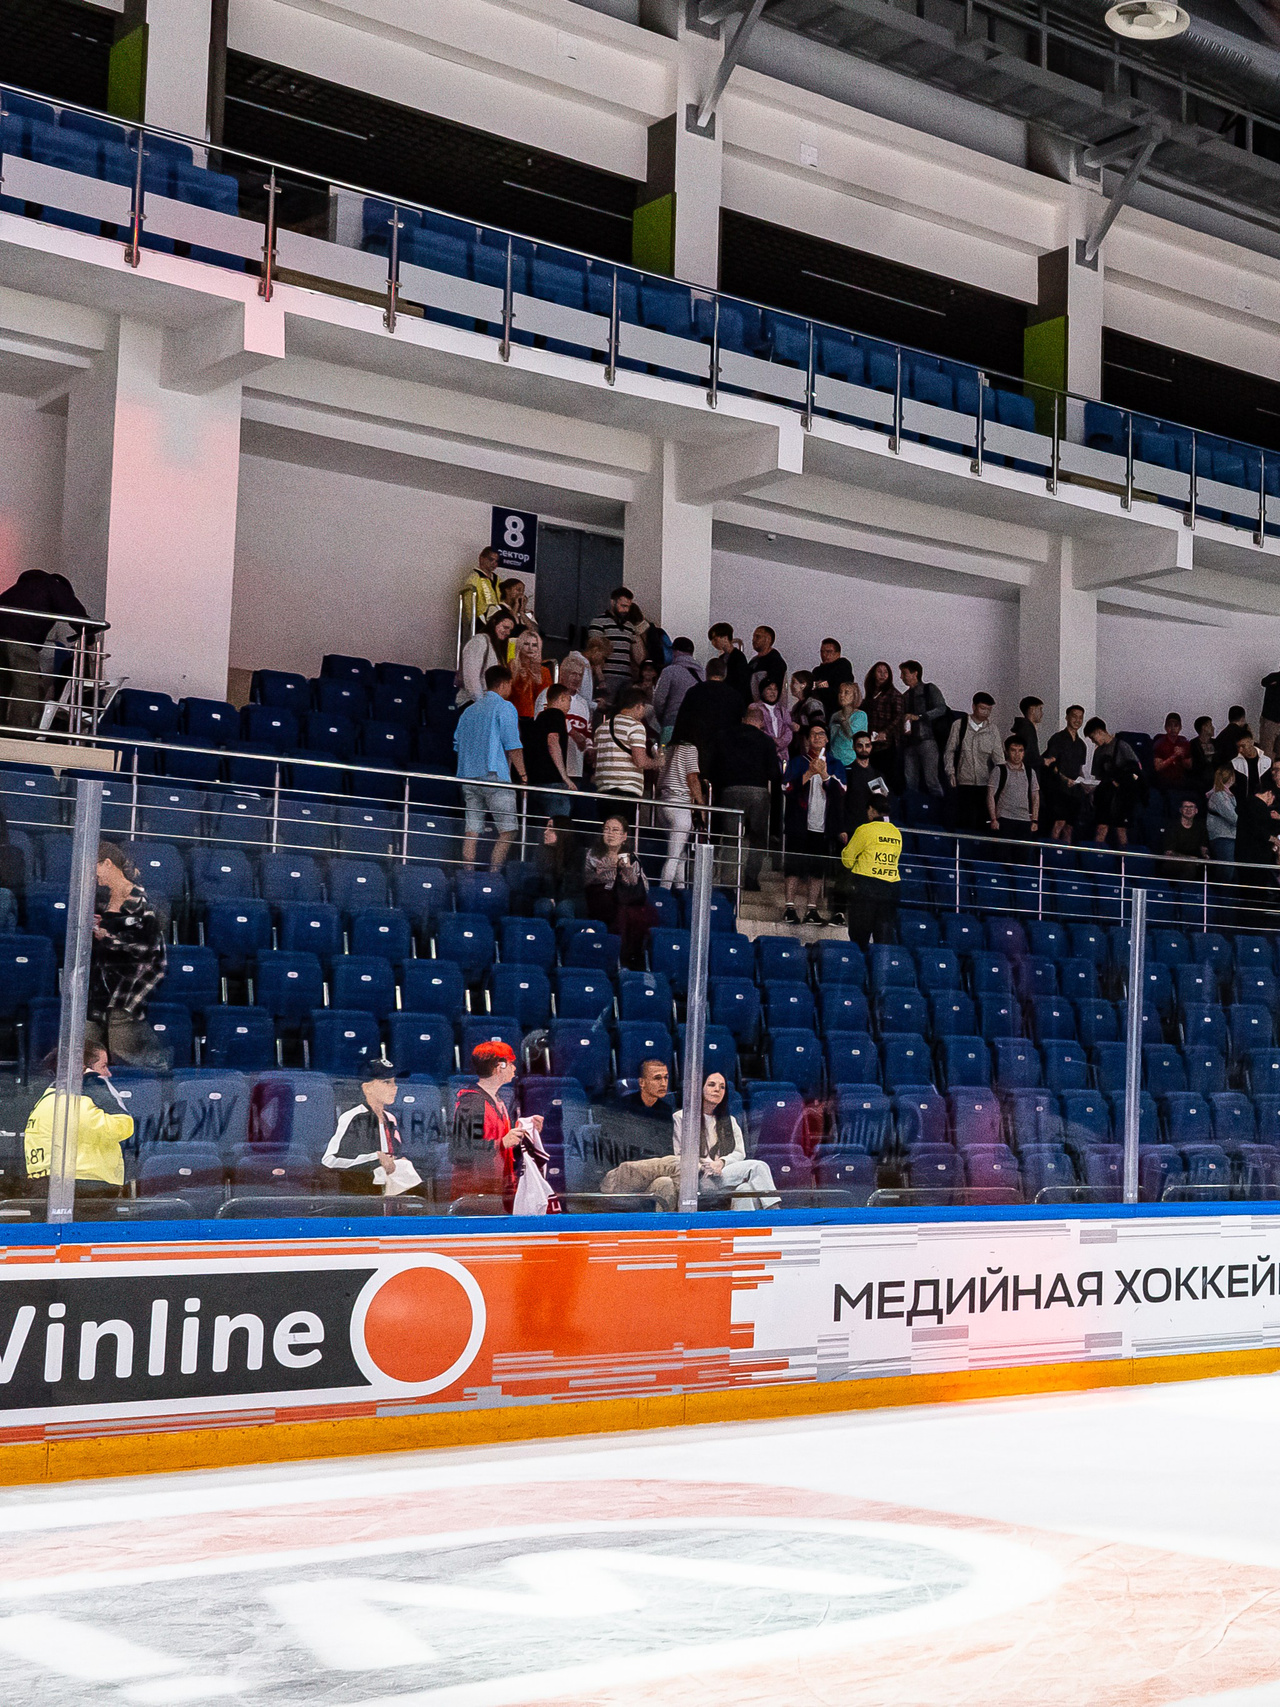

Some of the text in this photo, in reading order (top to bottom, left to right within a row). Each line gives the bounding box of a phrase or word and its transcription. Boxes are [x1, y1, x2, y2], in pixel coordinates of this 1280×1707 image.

[503, 515, 525, 548] 8
[878, 836, 901, 846] SAFETY
[833, 1265, 1104, 1327] МЕДИЙНАЯ
